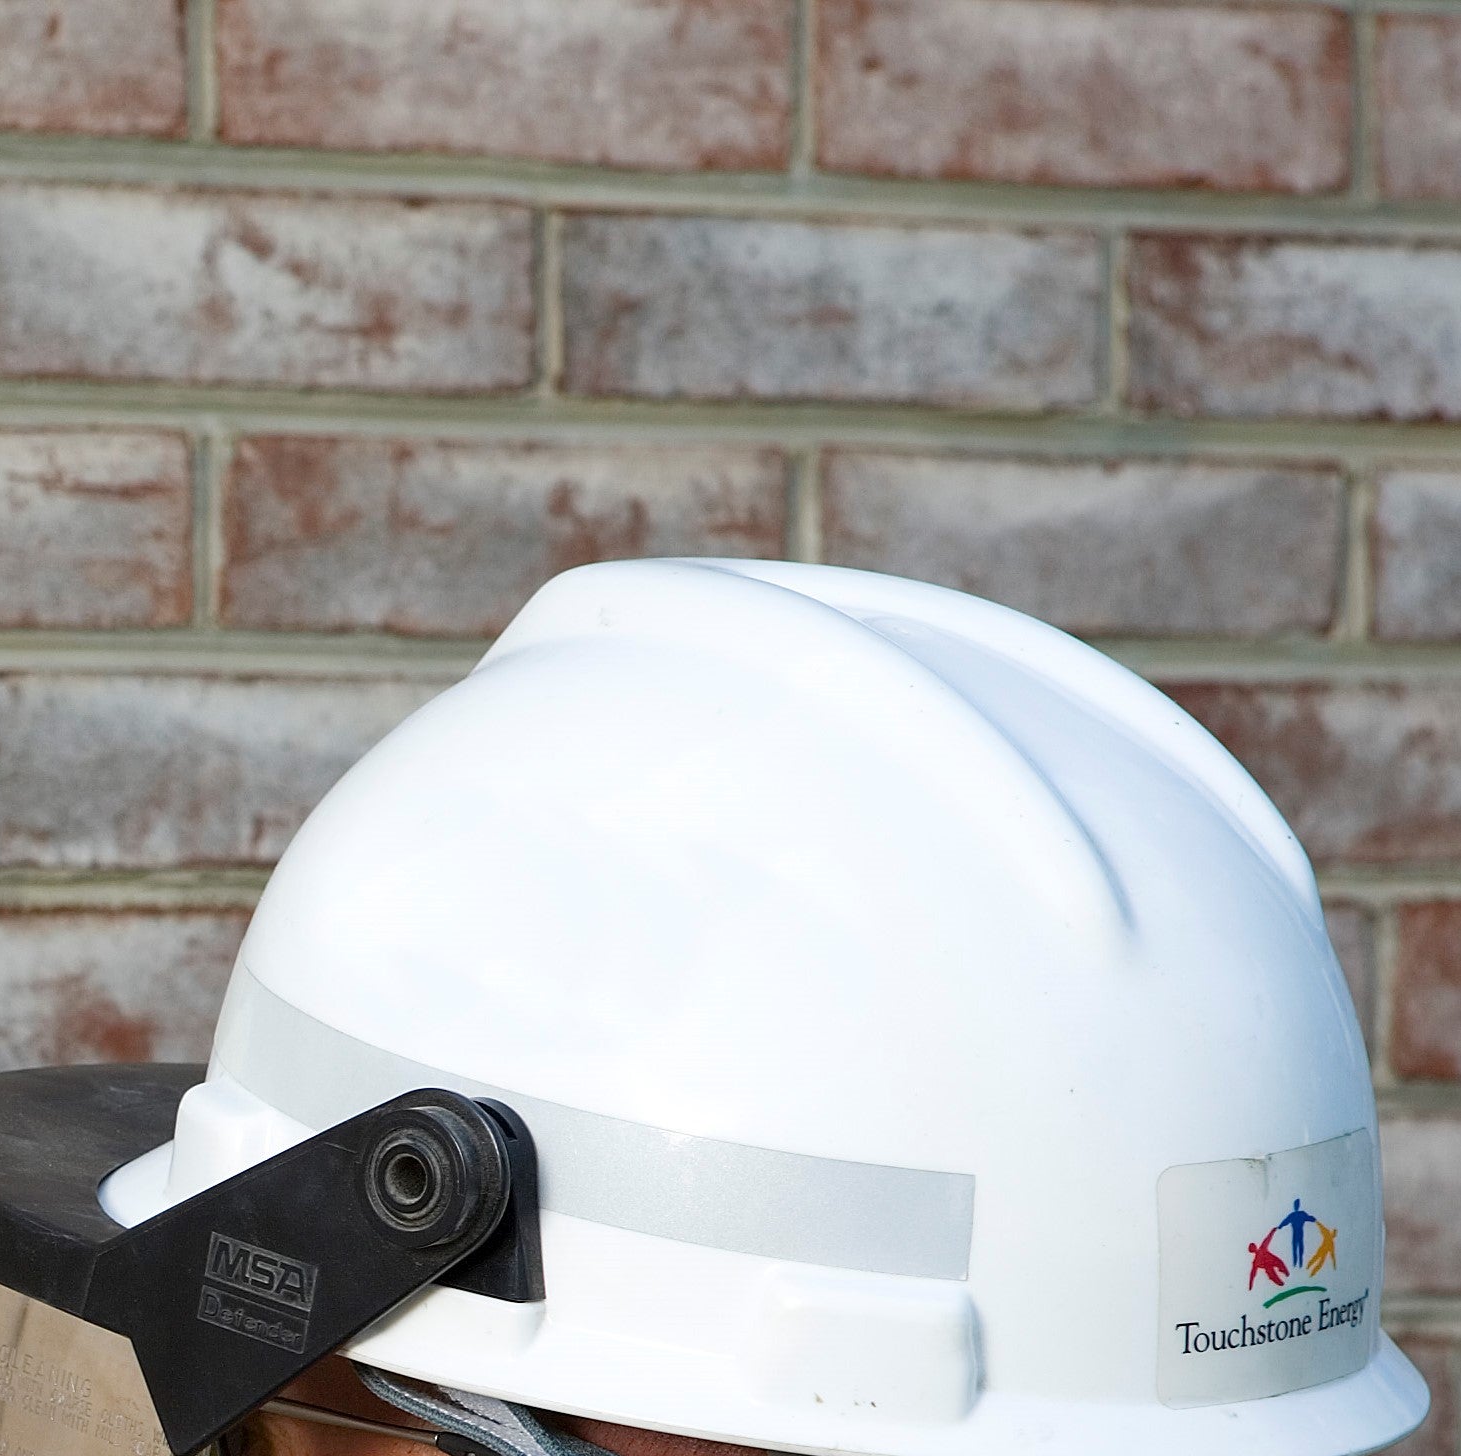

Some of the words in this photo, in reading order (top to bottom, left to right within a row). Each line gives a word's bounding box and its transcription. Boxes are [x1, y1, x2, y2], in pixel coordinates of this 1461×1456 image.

[212, 1239, 310, 1304] MSA
[203, 1293, 303, 1345] Defender
[1175, 1314, 1312, 1354] Touchstone
